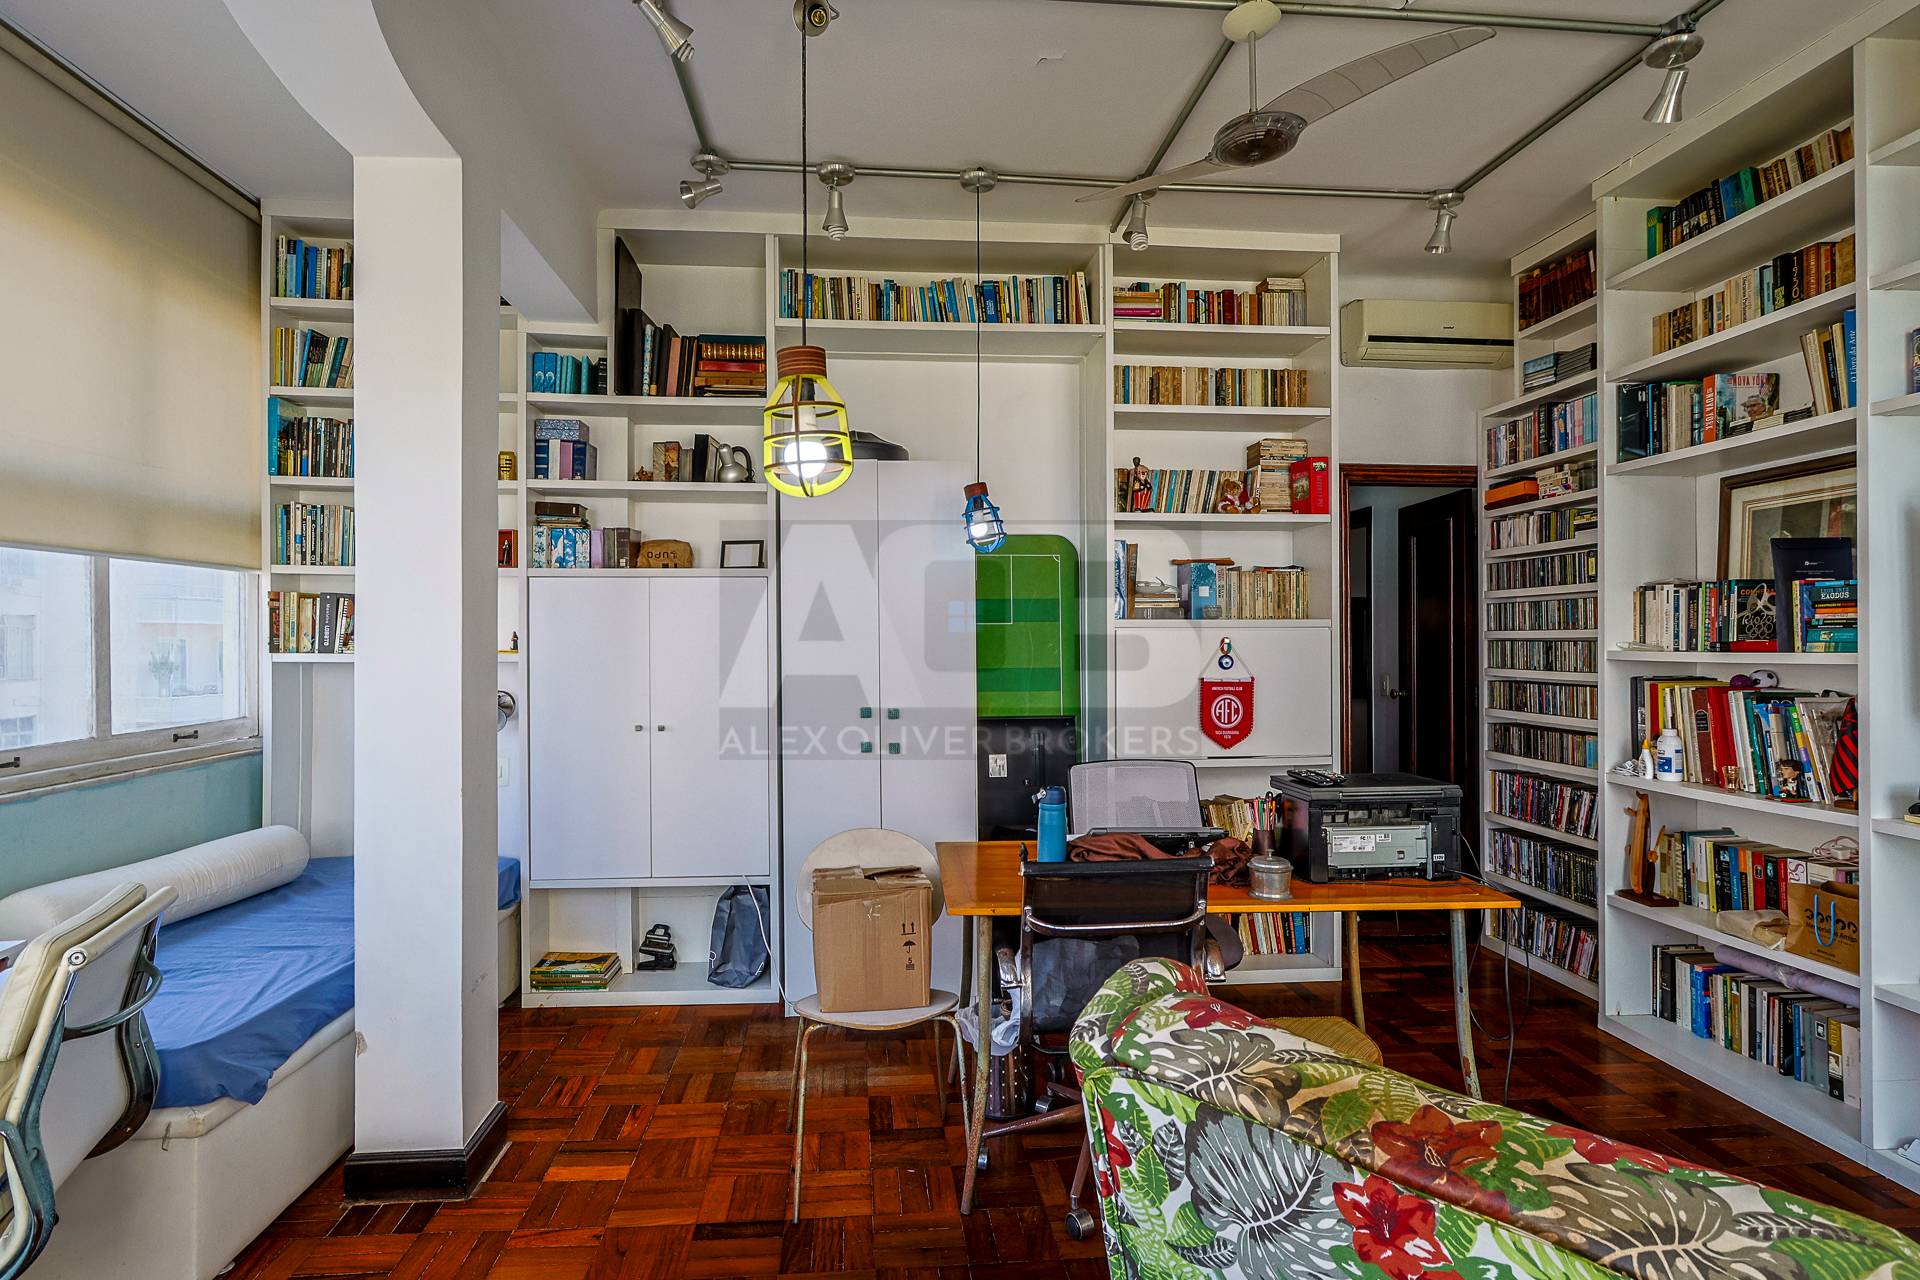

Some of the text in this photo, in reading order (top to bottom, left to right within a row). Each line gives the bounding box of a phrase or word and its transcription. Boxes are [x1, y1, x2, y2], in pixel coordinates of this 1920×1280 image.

[1705, 392, 1715, 431] NOVA YORK
[1216, 700, 1237, 723] AFC
